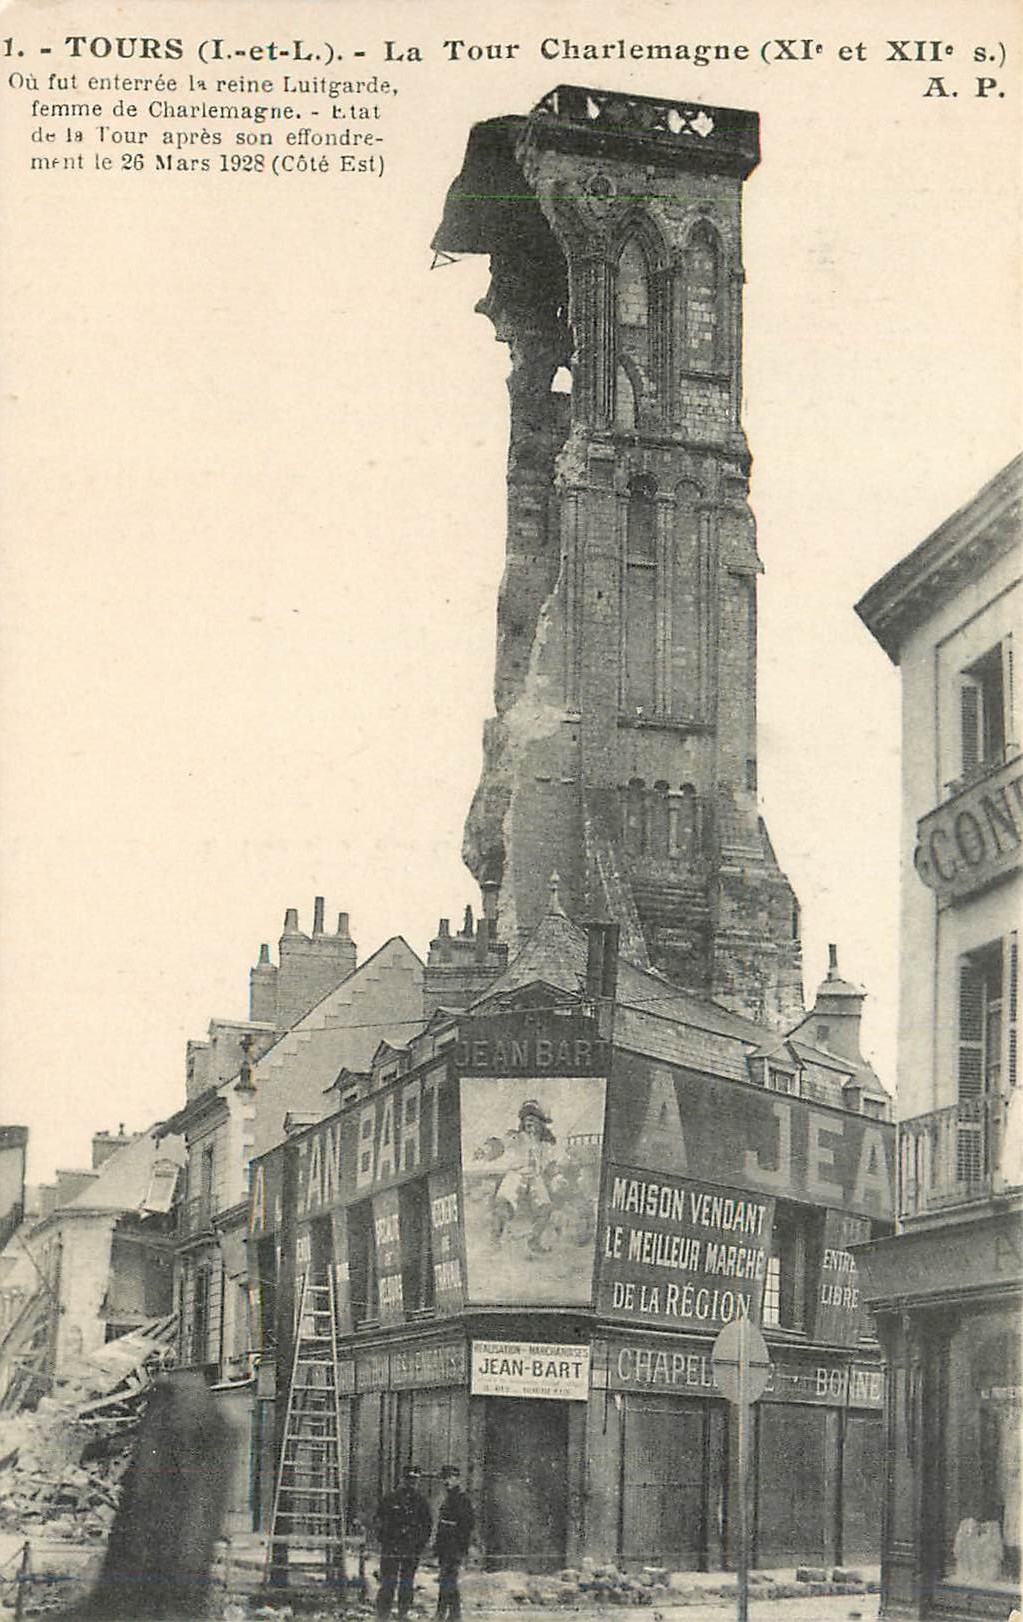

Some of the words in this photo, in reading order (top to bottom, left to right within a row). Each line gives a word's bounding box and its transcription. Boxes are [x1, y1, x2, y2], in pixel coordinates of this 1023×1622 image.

[455, 1039, 529, 1067] JEAN
[611, 1177, 685, 1221] MAISON
[690, 1191, 767, 1236] VENDANT
[604, 1225, 624, 1259] LE
[628, 1229, 700, 1272] MEILLEUR
[613, 1281, 636, 1310] DE
[639, 1285, 660, 1314] LA
[666, 1281, 751, 1322] RÉGION
[820, 1284, 859, 1309] LIBRE
[479, 1357, 583, 1379] JEAN-BART
